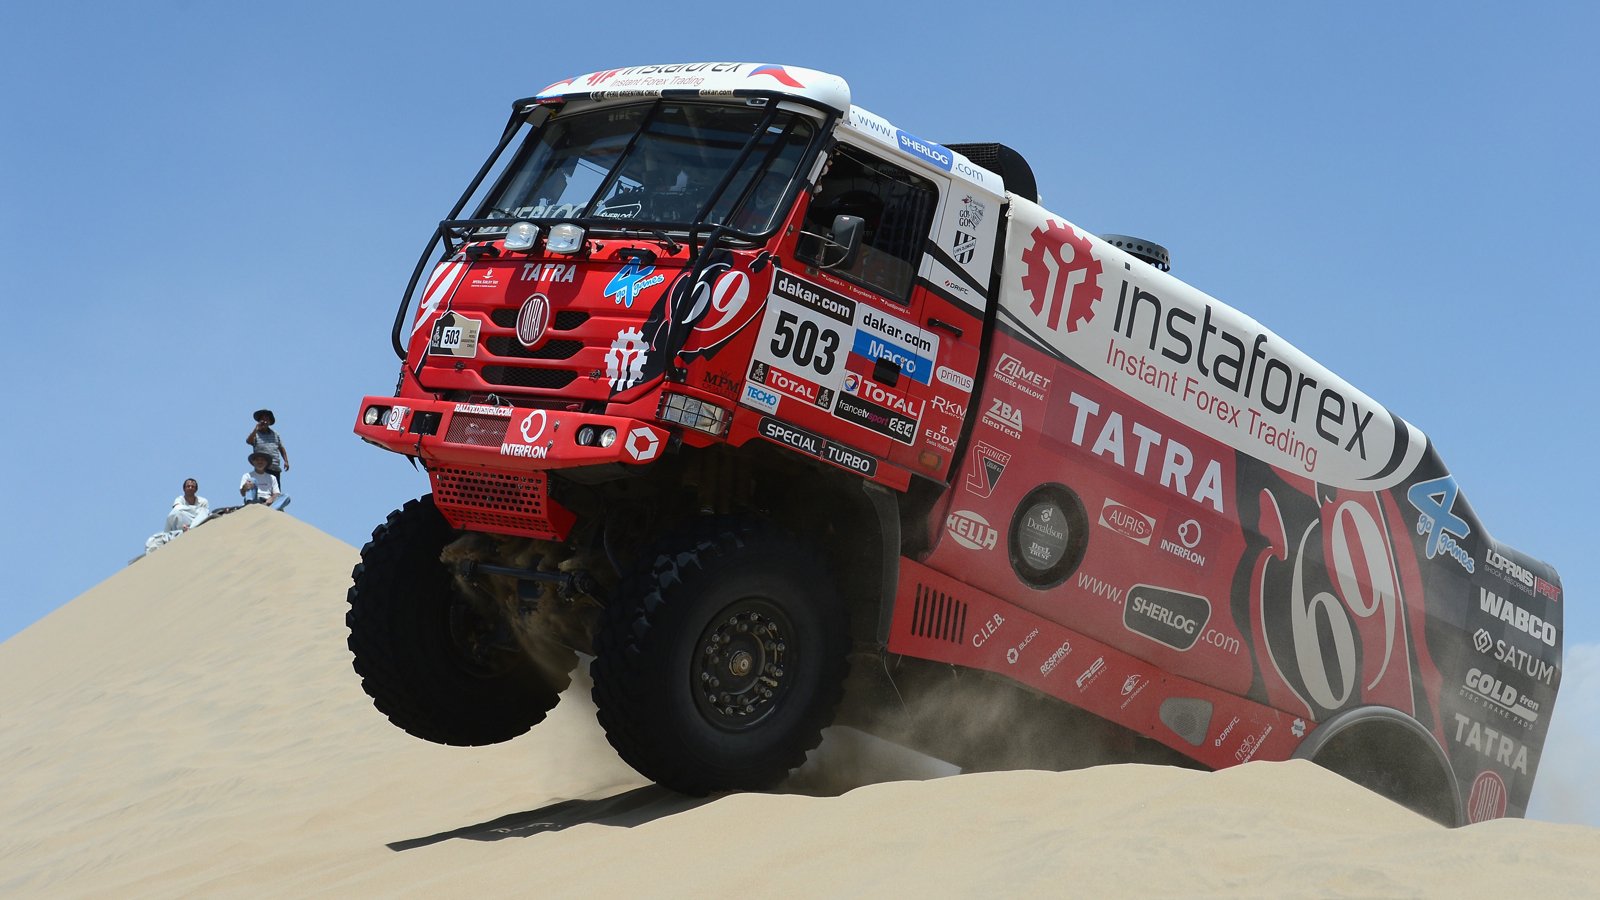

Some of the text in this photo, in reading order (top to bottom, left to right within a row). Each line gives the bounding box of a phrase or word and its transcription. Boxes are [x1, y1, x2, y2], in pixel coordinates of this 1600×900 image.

[610, 76, 704, 87] Instant Forex Trading
[700, 88, 732, 96] dakar.com
[858, 114, 984, 182] www. SHERLOG .com
[520, 263, 577, 283] TATRA
[633, 274, 665, 296] games
[778, 277, 851, 318] dakar.com
[444, 329, 460, 344] 503
[770, 310, 840, 376] 503
[863, 312, 932, 352] dakar.com
[1113, 262, 1374, 461] instaforex
[703, 371, 739, 393] MPM
[770, 370, 815, 400] TOTAL
[940, 369, 971, 388] primus
[993, 372, 1017, 388] HRADEC
[454, 404, 513, 416] RALLYEDESIGN.COM
[747, 386, 777, 406] TECHO
[863, 380, 917, 417] TOTAL
[931, 396, 967, 417] RKM
[1106, 338, 1318, 472] Instant Forex Trading
[989, 397, 1022, 426] ZBA
[925, 429, 957, 447] EDOX
[981, 416, 1021, 440] GeoTech
[500, 443, 548, 459] INTERFLON
[766, 423, 871, 472] SPECIAL TURBO
[983, 446, 1007, 463] SILNICE
[1069, 391, 1224, 513] TATRA
[947, 514, 998, 550] HELLA
[1027, 517, 1063, 540] Donaldson
[1109, 510, 1146, 535] AURIS
[1407, 474, 1471, 560] 4
[1160, 539, 1206, 567] INTERFLON
[1437, 532, 1475, 574] games
[1485, 548, 1534, 587] LOPRAIS
[1484, 564, 1502, 579] SHOCK
[1077, 572, 1241, 655] www. SHERLOG .com
[1291, 500, 1396, 710] 69
[1480, 586, 1556, 647] WABCO
[972, 613, 1005, 648] C.I.E.B.
[1040, 641, 1070, 674] RESPIRO
[1494, 639, 1554, 685] SATUM
[1466, 667, 1518, 706] GOLD
[1483, 701, 1510, 719] BRAKE
[1513, 716, 1534, 731] PADS
[1454, 712, 1528, 775] TATRA
